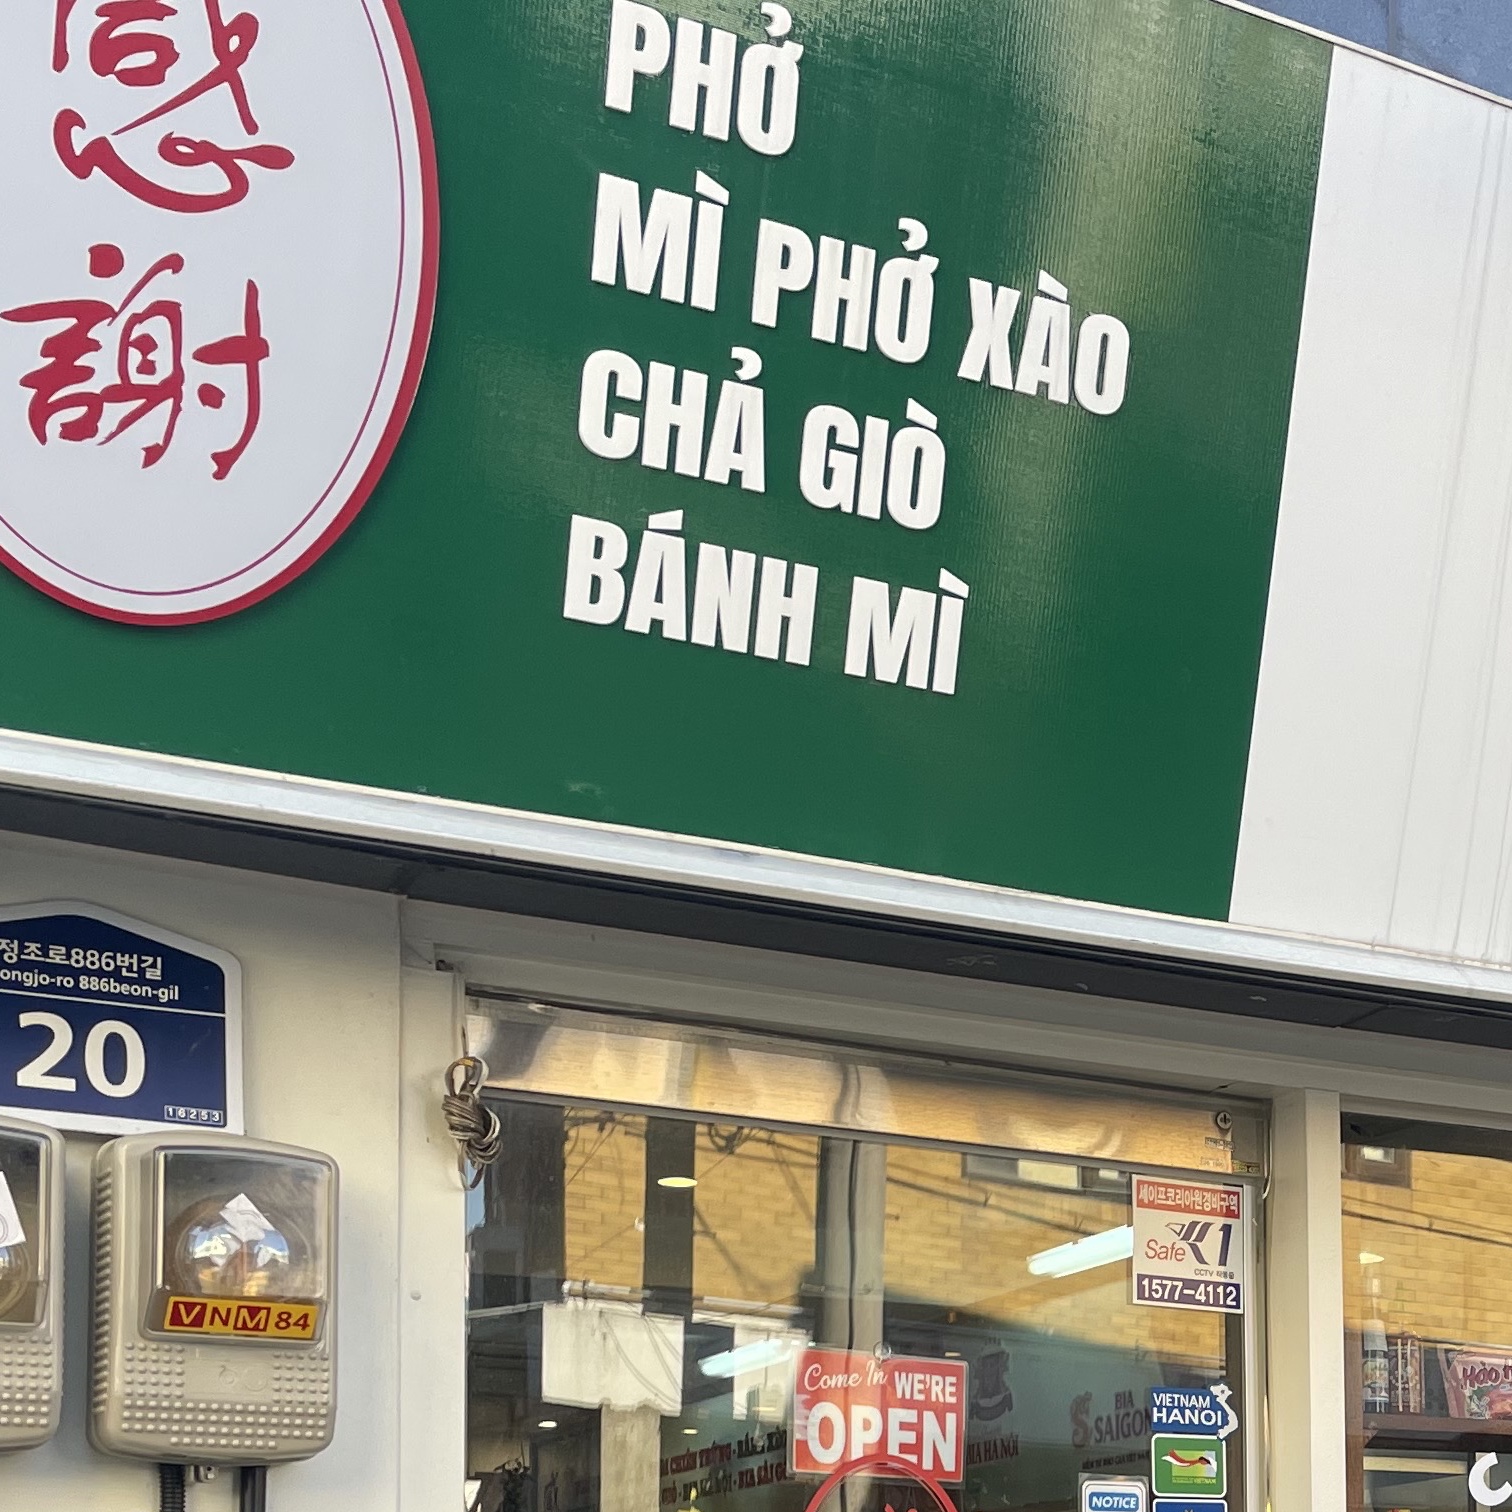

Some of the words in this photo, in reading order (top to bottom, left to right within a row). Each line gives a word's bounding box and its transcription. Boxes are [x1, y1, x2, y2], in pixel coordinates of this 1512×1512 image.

[604, 0, 804, 156] PHỞ
[591, 170, 730, 311] MÌ
[751, 217, 939, 363] PHỞ
[957, 269, 1131, 416] XÀO
[578, 346, 766, 493] CHẢ
[799, 398, 946, 530] GIÒ
[563, 508, 820, 667] BÁNH
[844, 567, 970, 695] MÌ
[0, 938, 163, 981] 정조로886번길
[79, 975, 179, 1002] 886beon-gil
[16, 1012, 146, 1098] 20
[166, 1106, 223, 1124] 16253
[1144, 1239, 1186, 1262] Safe
[1194, 1269, 1214, 1277] CCTV
[1142, 1277, 1237, 1306] 1577-4112
[170, 1302, 270, 1332] VNM
[275, 1310, 312, 1331] 84
[804, 1363, 862, 1392] Come
[865, 1360, 889, 1387] In
[894, 1370, 958, 1403] WE'RE
[1115, 1389, 1135, 1409] BIA
[1153, 1393, 1211, 1409] VIETNAM
[1153, 1407, 1222, 1426] HANOI
[807, 1401, 956, 1472] OPEN
[1091, 1496, 1138, 1509] NOTICE
